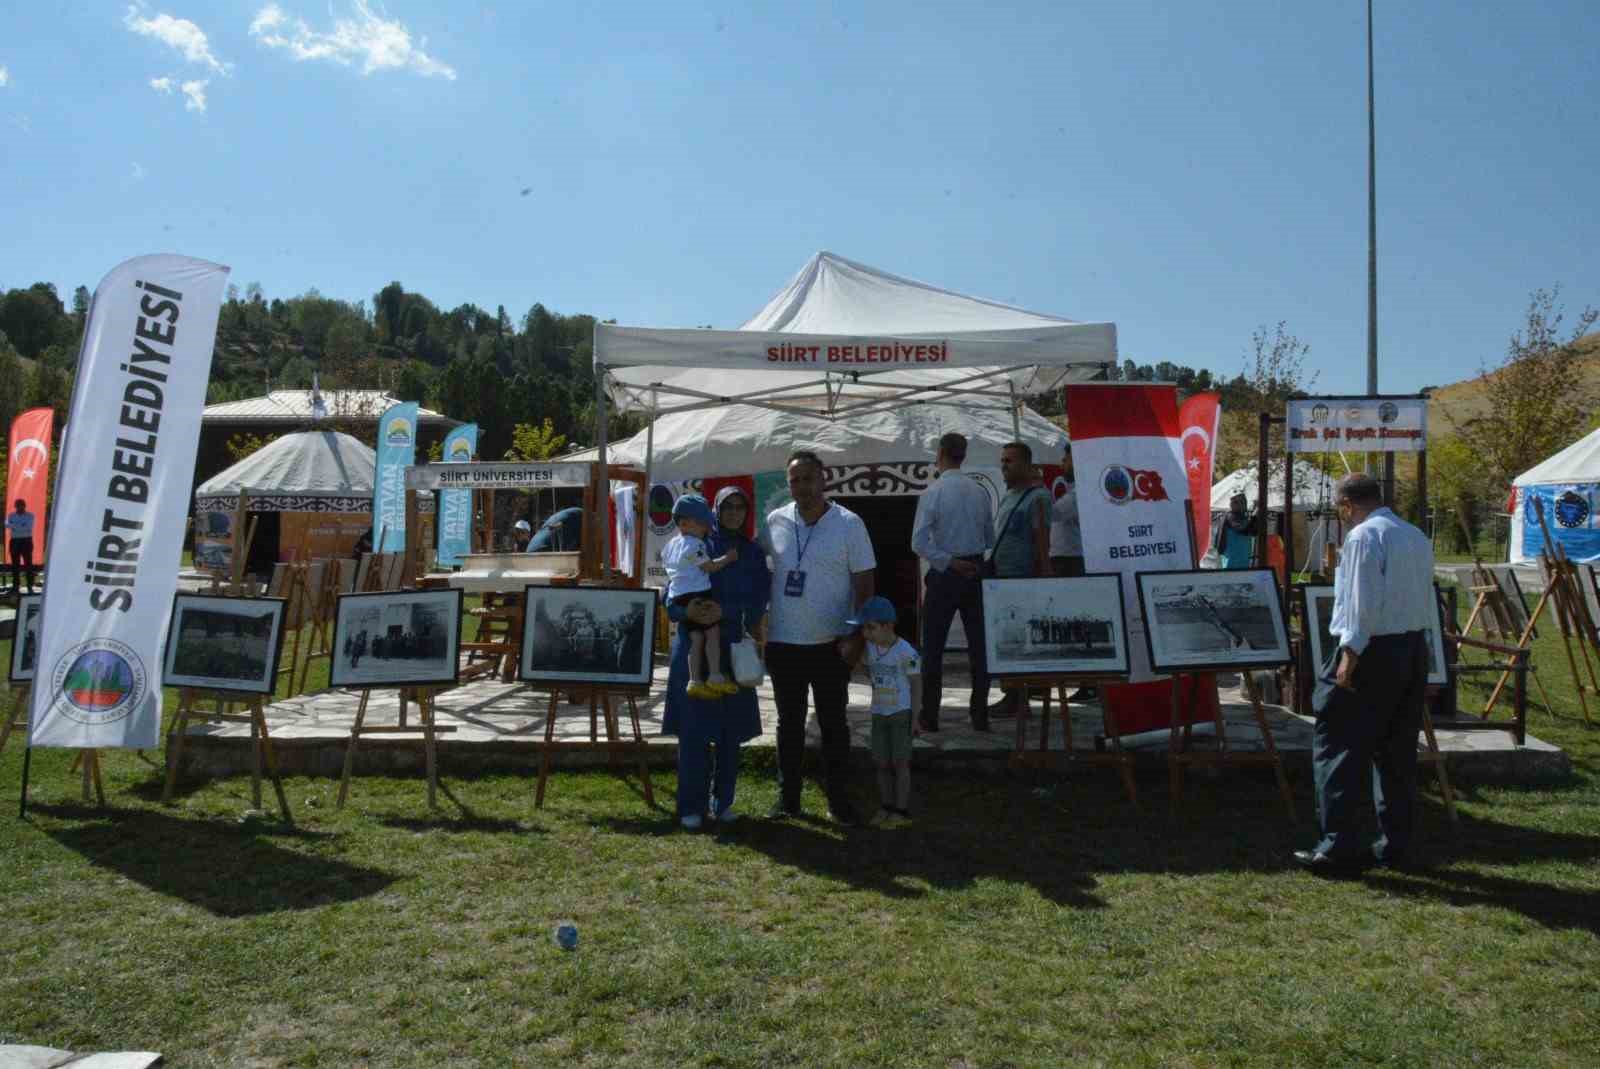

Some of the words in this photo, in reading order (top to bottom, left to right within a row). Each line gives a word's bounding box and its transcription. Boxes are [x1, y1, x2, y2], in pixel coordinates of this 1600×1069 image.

[767, 342, 821, 362] SİİRT
[827, 341, 947, 362] BELEDİYESİ
[107, 280, 183, 504] BELEDİYESİ
[440, 469, 470, 481] SİİRT
[474, 467, 552, 481] ÜNİVERSİTESİ
[1128, 524, 1154, 538] SİİRT
[1109, 541, 1176, 559] BELEDİYESİ
[85, 508, 144, 613] SİİRT
